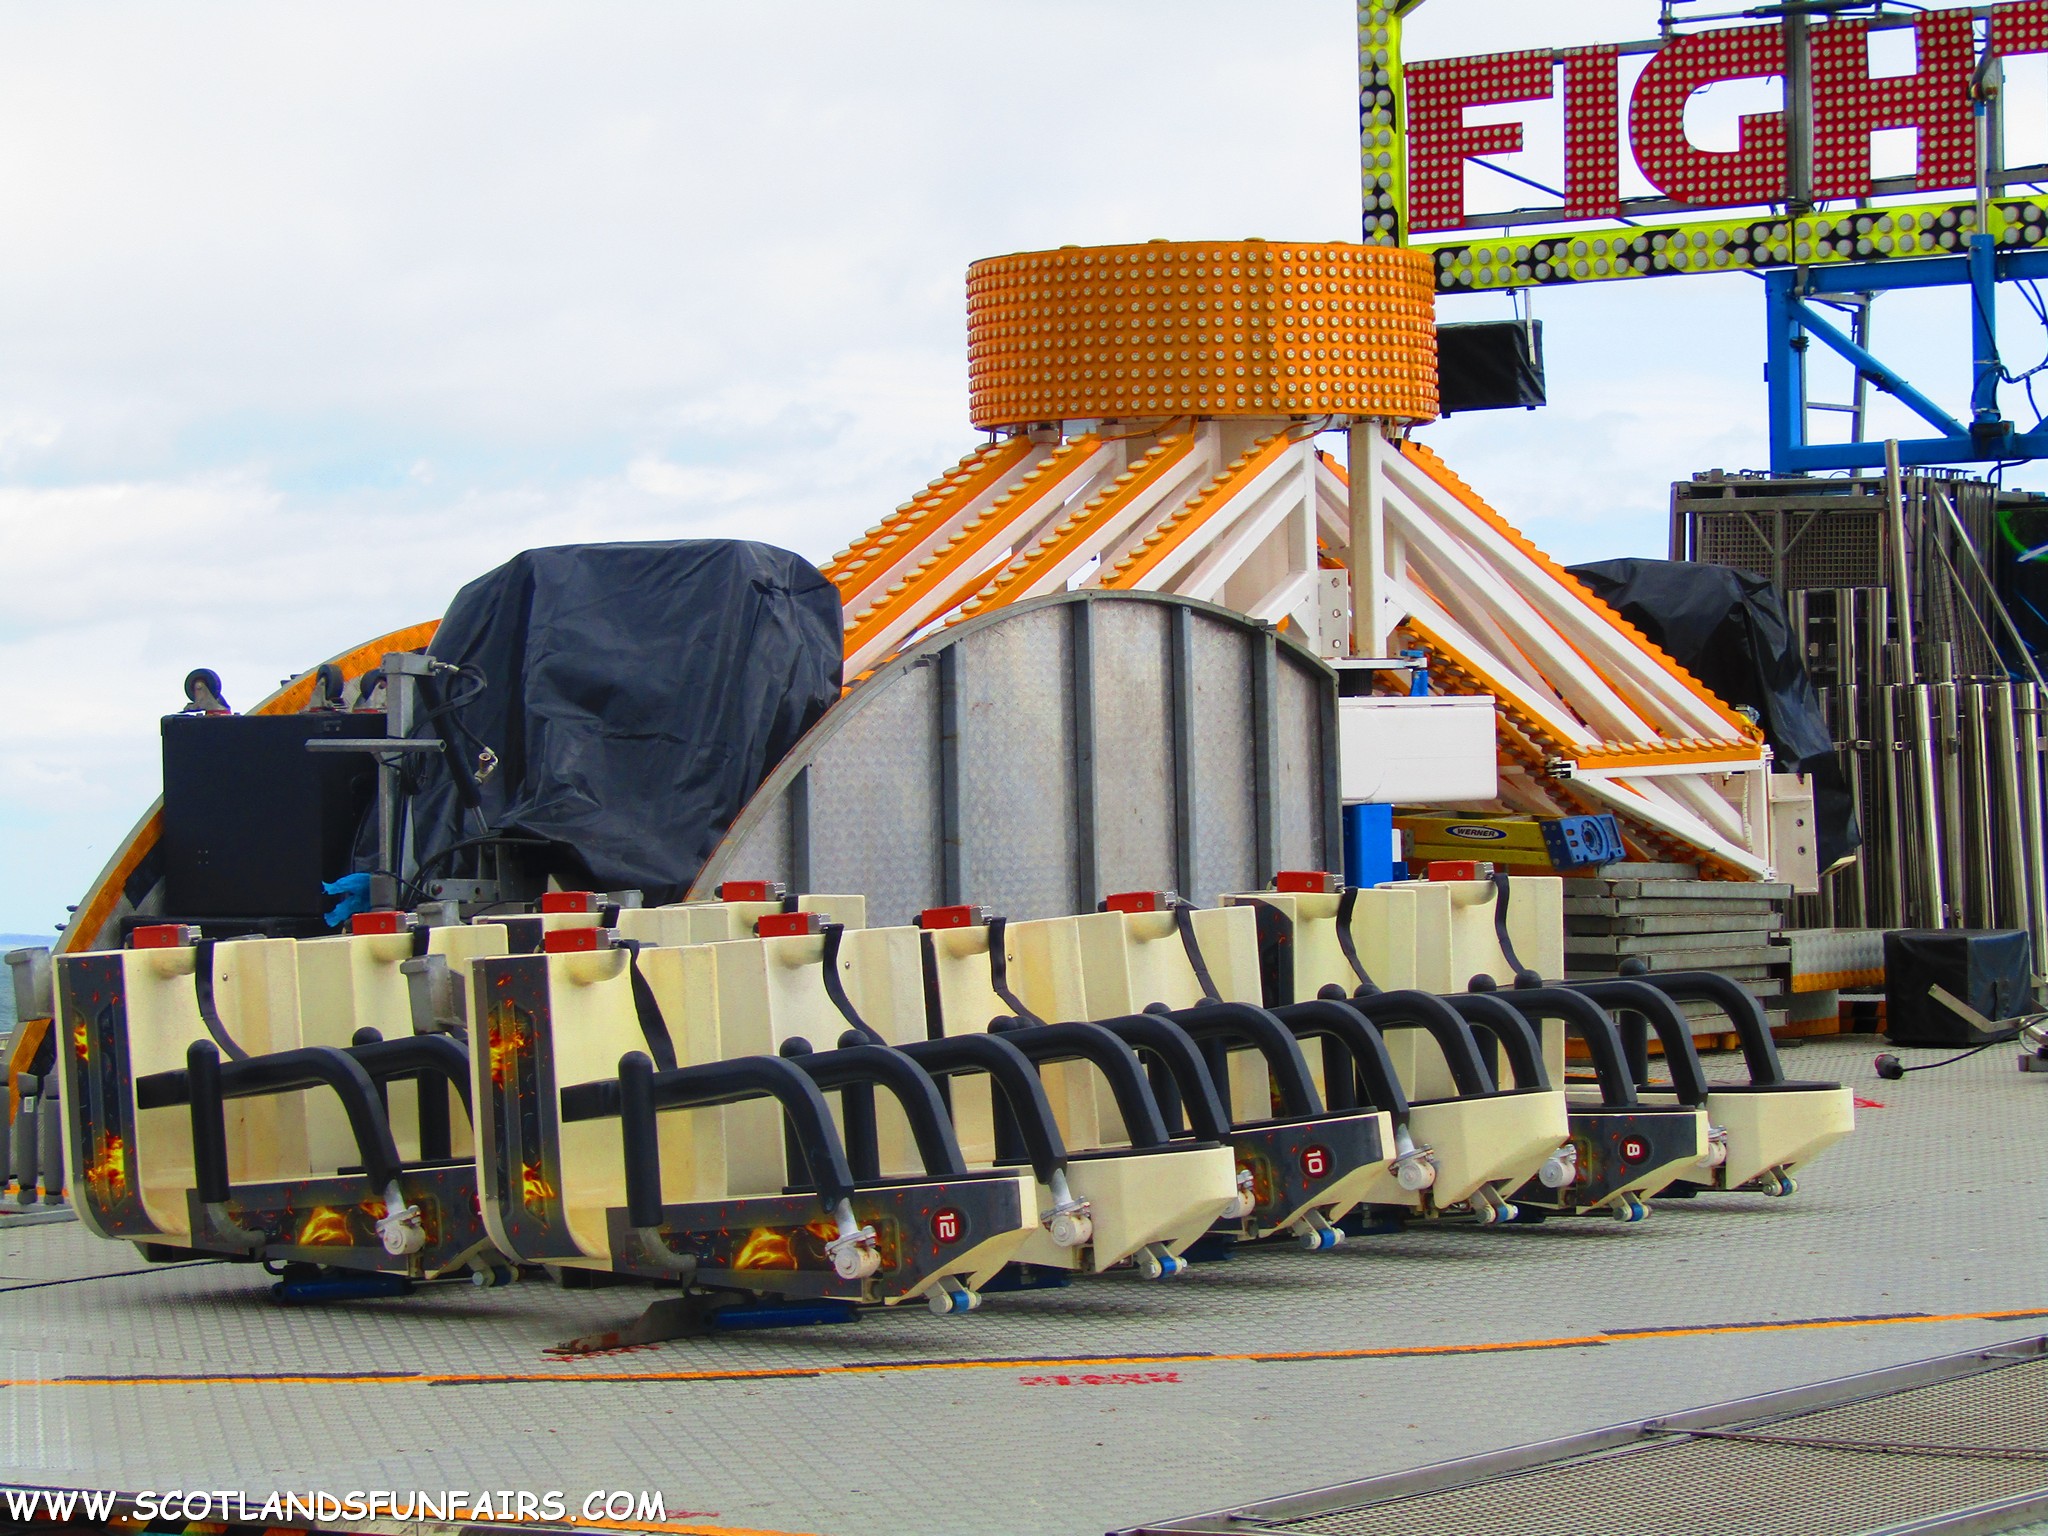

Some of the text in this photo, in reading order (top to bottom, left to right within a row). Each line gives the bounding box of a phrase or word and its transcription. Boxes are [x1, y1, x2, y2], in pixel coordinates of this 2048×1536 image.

[1406, 1, 2048, 232] FIGH
[1456, 827, 1496, 838] WERNER
[1626, 1143, 1639, 1156] 8
[1306, 1150, 1323, 1174] 10
[938, 1212, 956, 1239] 12
